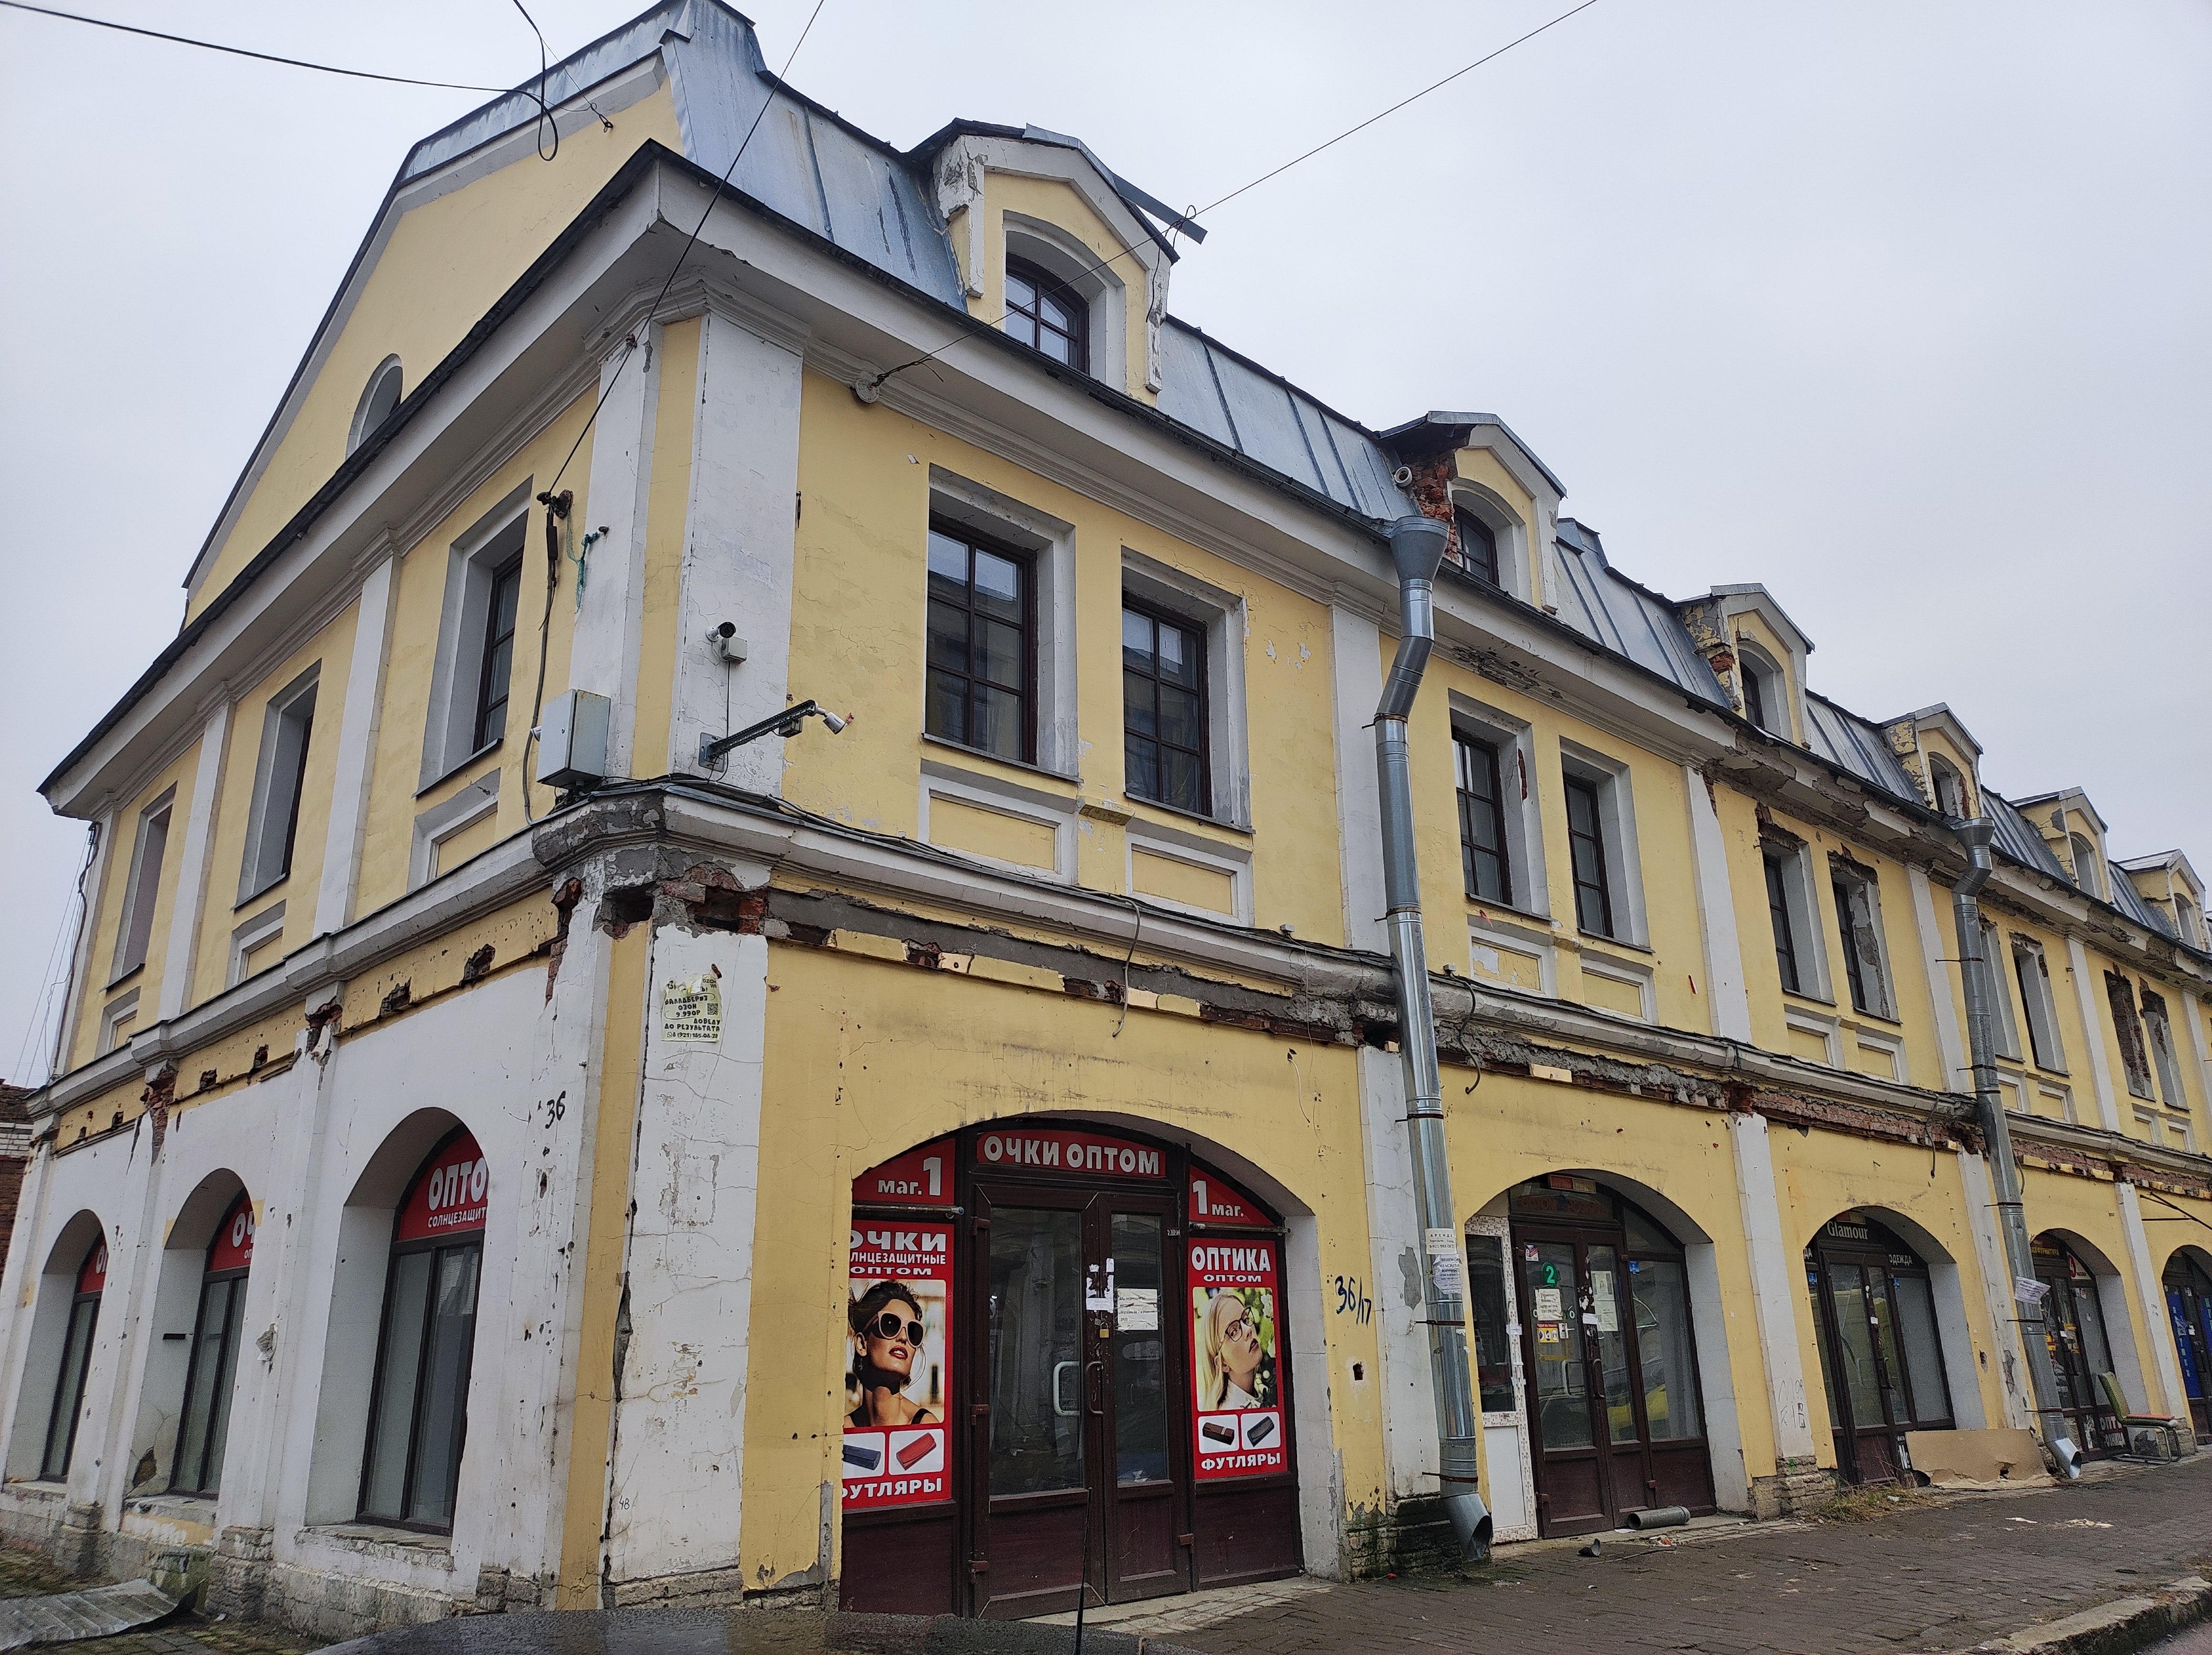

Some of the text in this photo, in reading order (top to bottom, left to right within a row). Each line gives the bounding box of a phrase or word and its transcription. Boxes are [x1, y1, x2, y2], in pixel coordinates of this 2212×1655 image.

[544, 1091, 566, 1129] 36
[984, 1135, 1159, 1175] ОЧКИ ОПТОМ
[429, 1157, 489, 1211] ОПТО
[923, 1157, 942, 1196] 1
[1192, 1180, 1208, 1214] 1
[428, 1206, 486, 1228] СОЛНЦЕЗАЩИТ
[1827, 1221, 1868, 1239] Glamour
[850, 1252, 946, 1265] ЛНЦЕЗАЩИТНЫЕ
[1192, 1246, 1271, 1271] ОПТИКА
[1889, 1254, 1913, 1266] ОДЕЖДА
[1546, 1266, 1555, 1283] 2
[1201, 1452, 1280, 1470] ФУТЛЯРЫ
